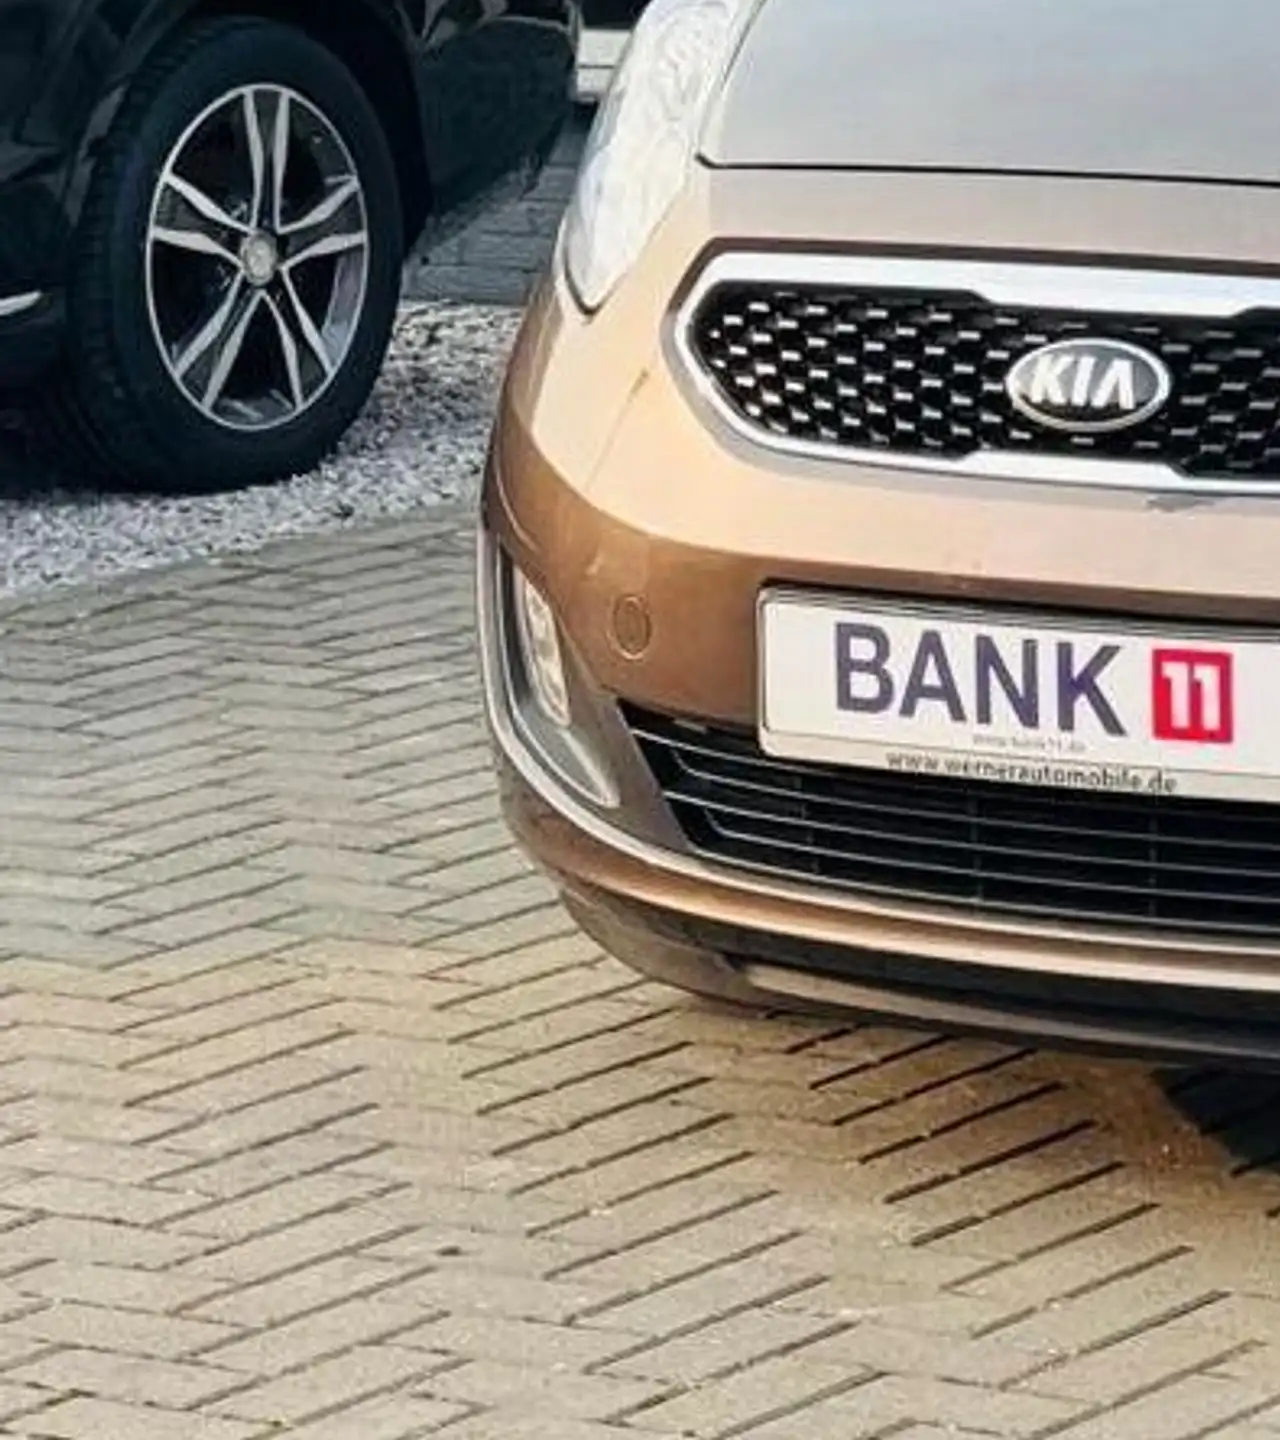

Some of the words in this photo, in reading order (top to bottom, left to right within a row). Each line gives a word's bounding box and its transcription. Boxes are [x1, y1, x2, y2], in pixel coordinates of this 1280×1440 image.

[1030, 352, 1136, 410] KIA
[834, 621, 1128, 737] BANK
[1158, 657, 1223, 734] 11
[884, 751, 1179, 793] www.wernerautomobile.de
